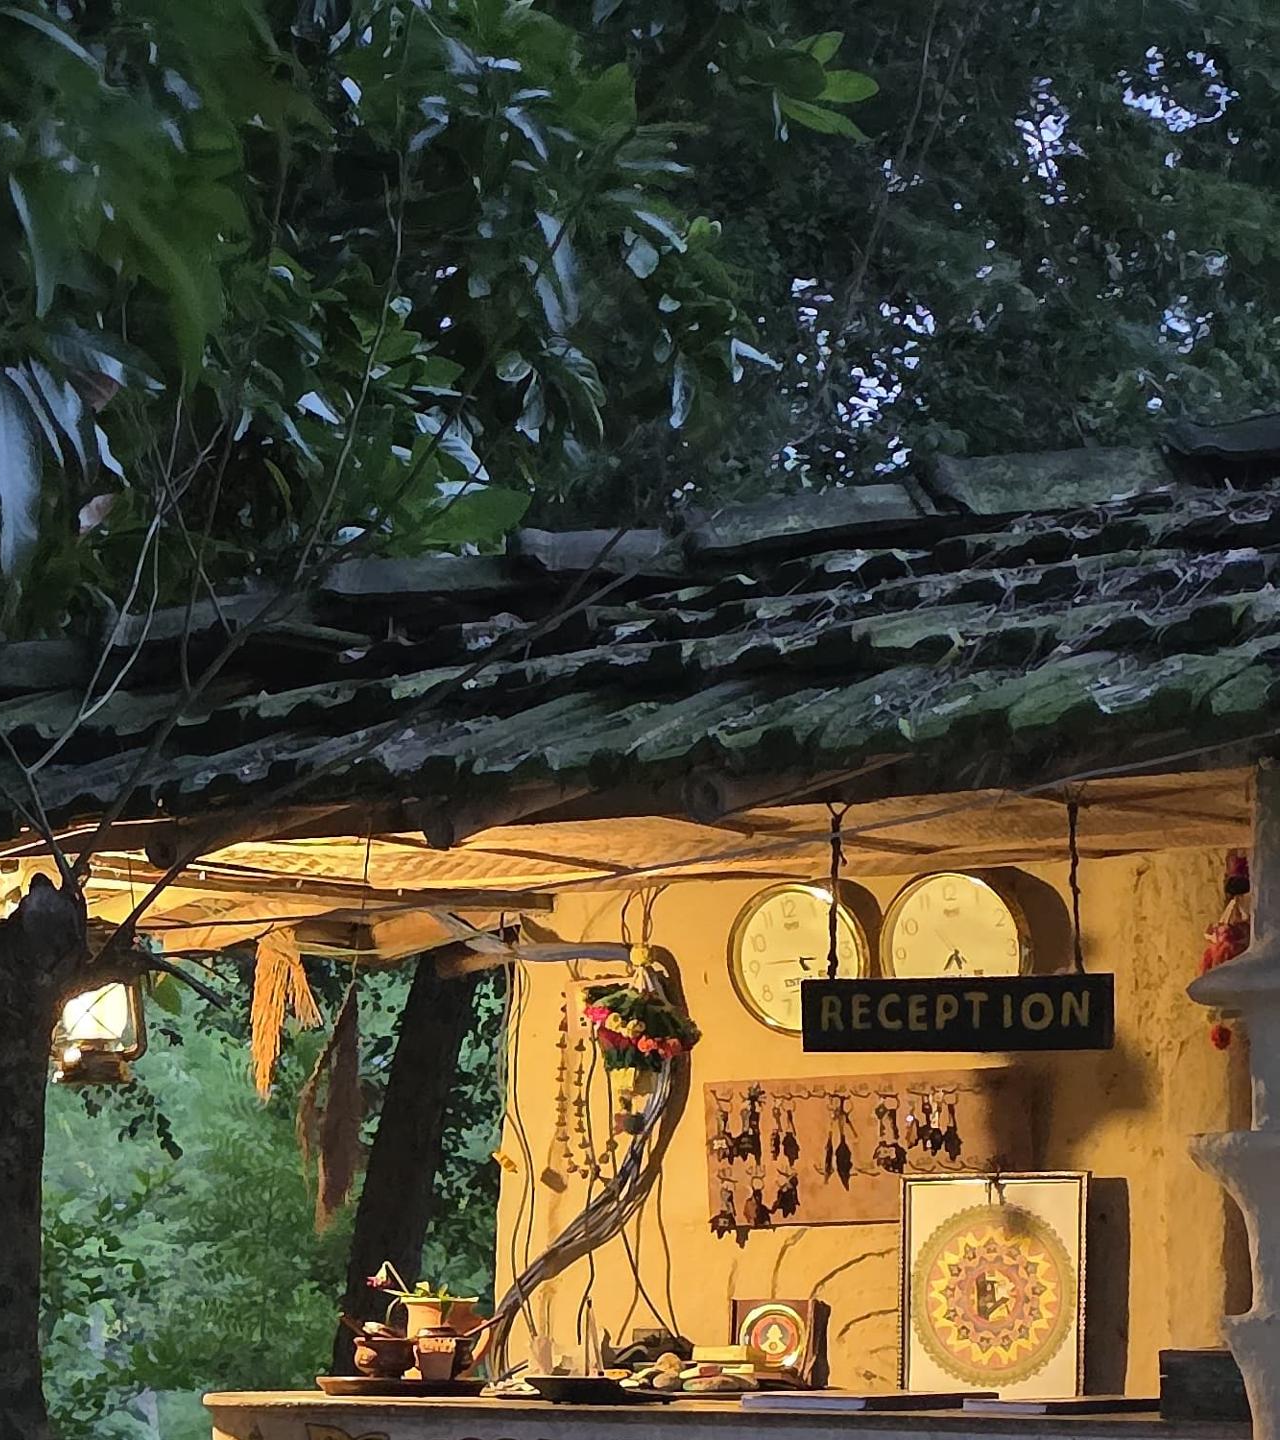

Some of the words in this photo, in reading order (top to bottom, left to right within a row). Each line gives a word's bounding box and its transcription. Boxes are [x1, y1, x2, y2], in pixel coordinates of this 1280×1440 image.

[780, 899, 797, 918] 12
[993, 908, 1006, 927] 2
[761, 910, 774, 930] 11
[900, 917, 919, 936] 10
[750, 933, 767, 952] 10
[1006, 937, 1018, 957] 3
[895, 947, 907, 965] 9
[749, 959, 761, 978] 9
[761, 984, 774, 1002] 8
[821, 989, 1091, 1032] RECEPTION
